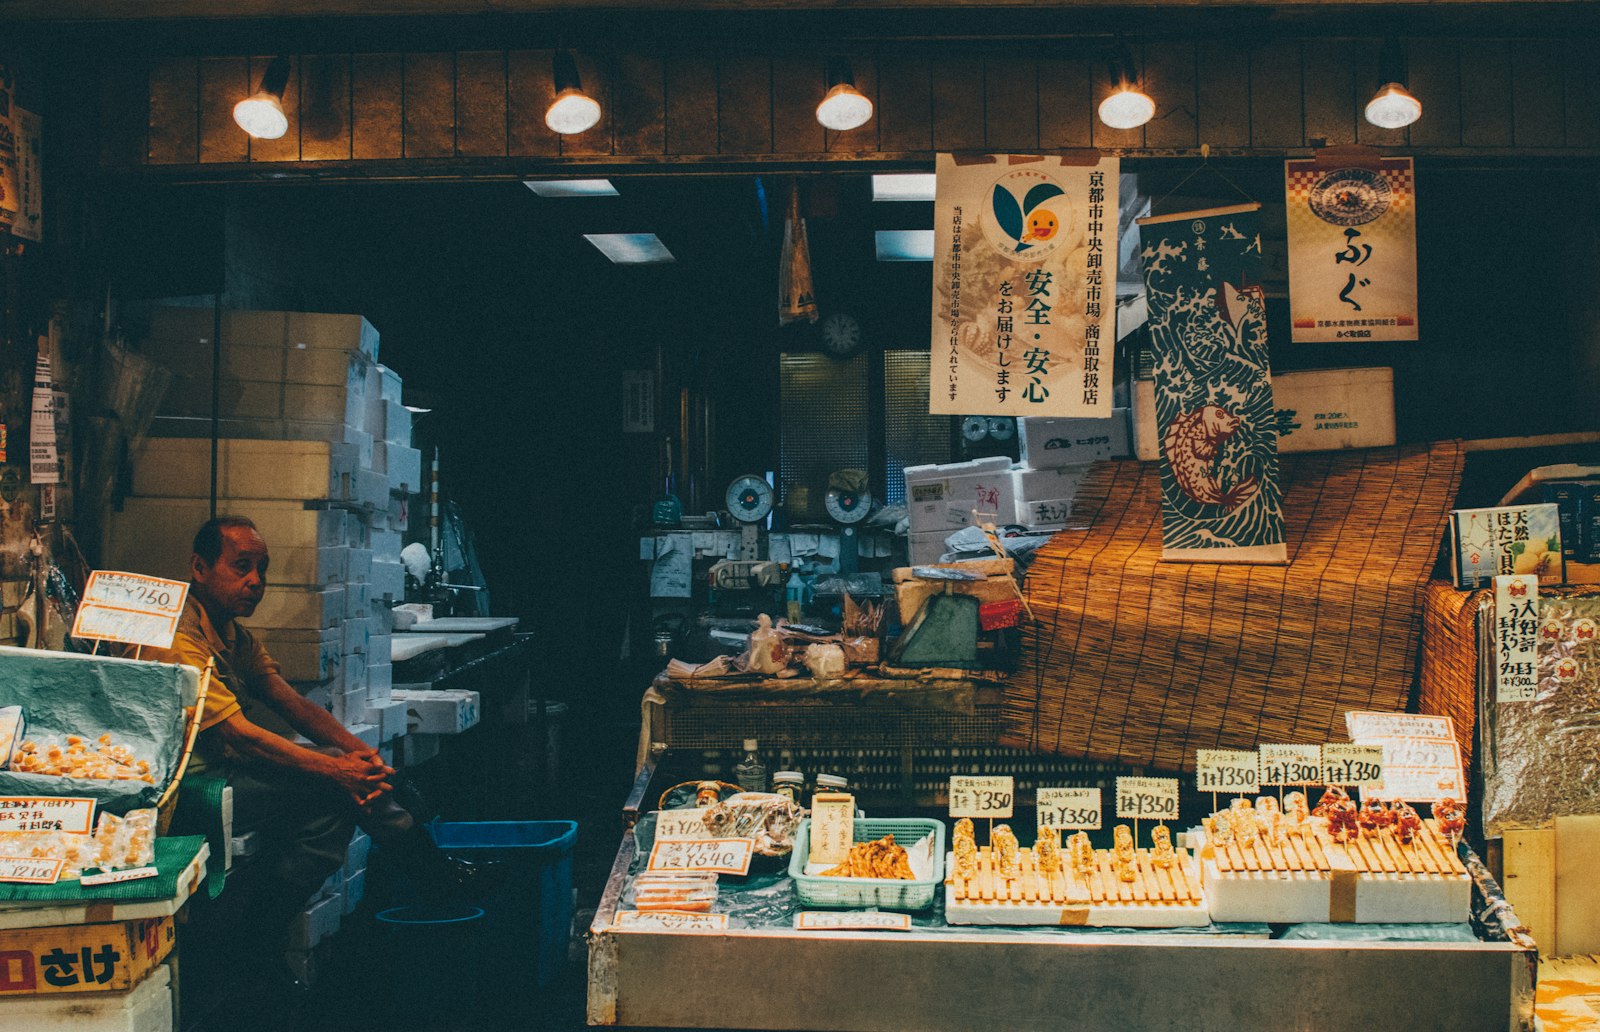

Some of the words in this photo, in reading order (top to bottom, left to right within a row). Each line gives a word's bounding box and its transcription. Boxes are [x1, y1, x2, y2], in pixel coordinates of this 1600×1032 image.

[1085, 171, 1104, 318] 京都市中央卸売市場
[1335, 228, 1372, 311] ふぐ
[948, 206, 962, 401] 当店は京都市中央卸売市場から仕入れています
[995, 281, 1012, 403] をお届けします
[1022, 269, 1053, 403] 安全・安心
[1082, 324, 1100, 405] 商品取扱店
[1512, 510, 1529, 541] 天然
[1509, 604, 1519, 648] うずら
[1520, 599, 1538, 652] 大好評
[41, 944, 121, 986] さけ
